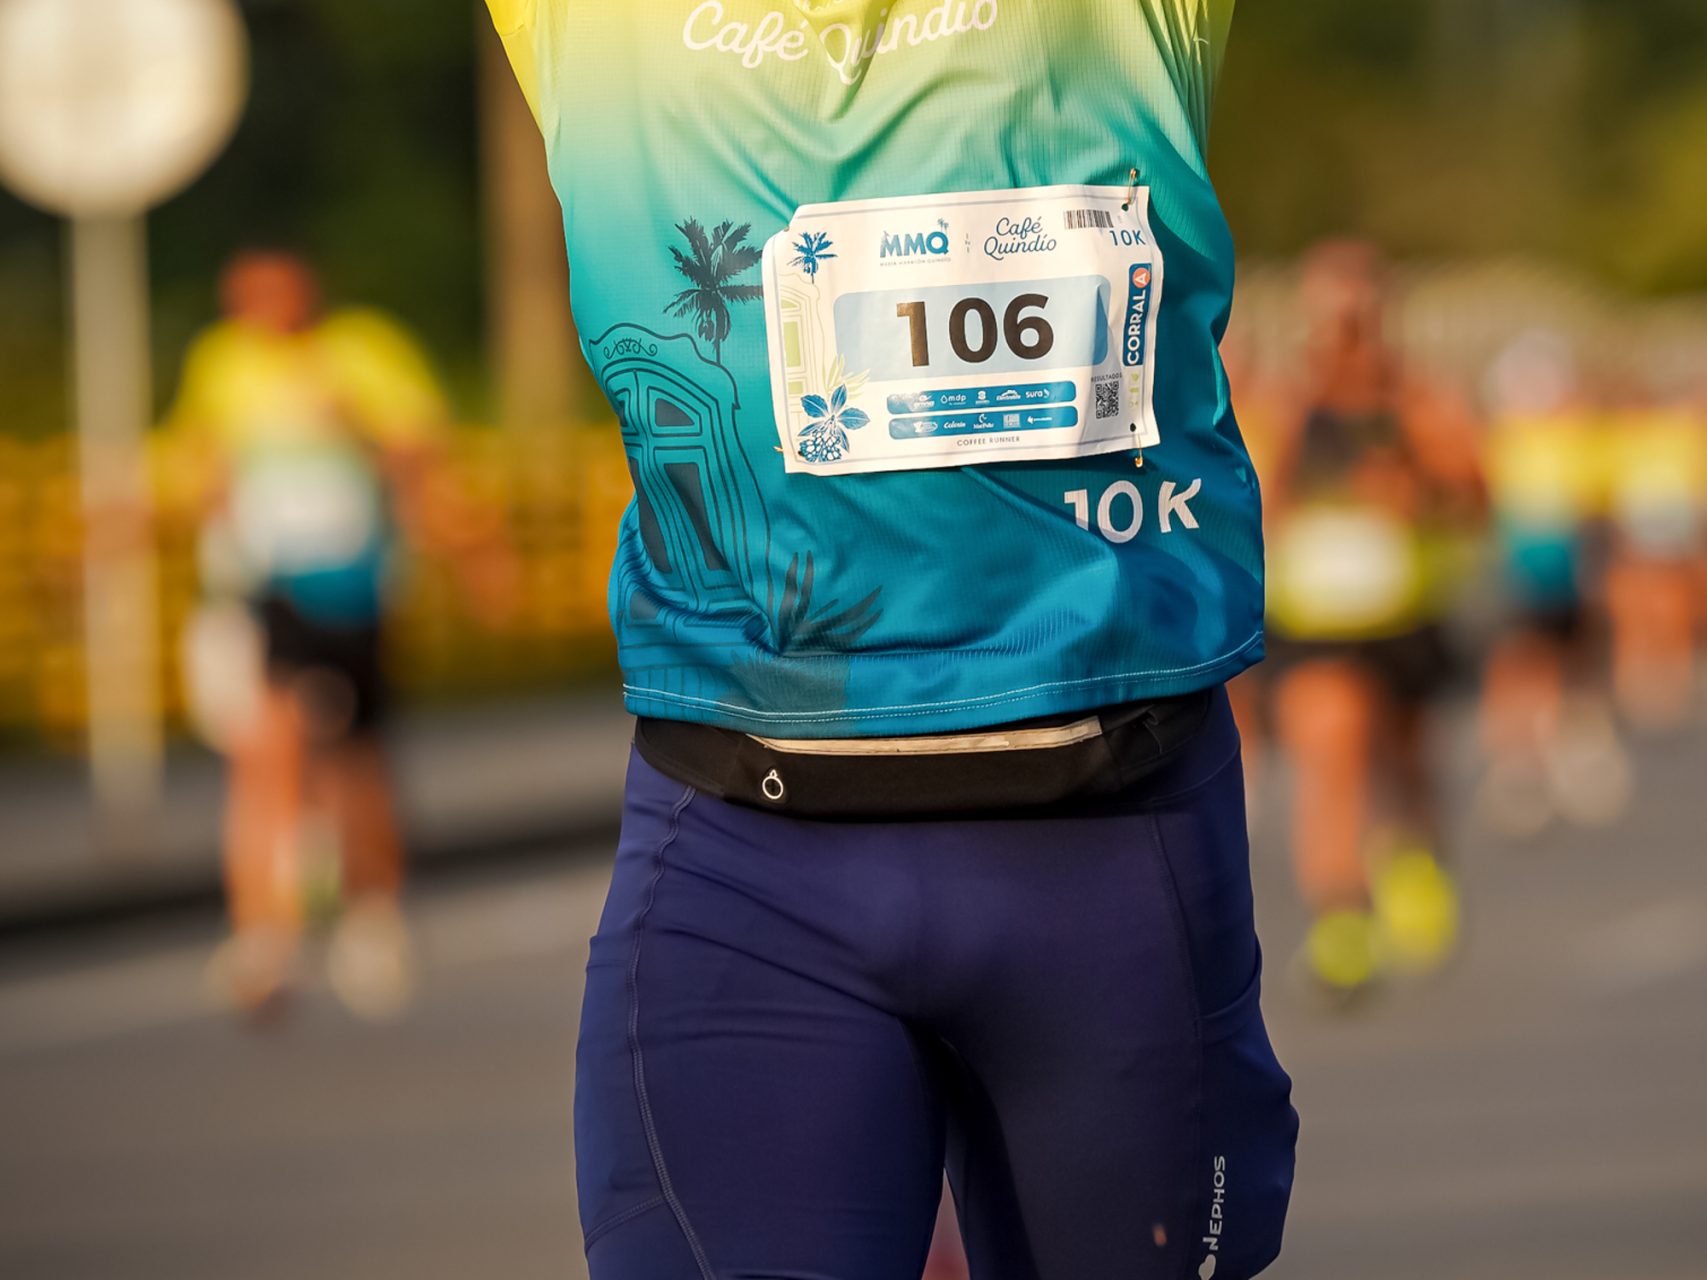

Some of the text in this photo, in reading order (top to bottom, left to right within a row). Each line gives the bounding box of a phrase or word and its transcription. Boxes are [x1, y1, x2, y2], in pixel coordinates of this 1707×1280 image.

[682, 0, 809, 68] Café
[996, 216, 1042, 240] Café
[1109, 229, 1146, 246] 10K
[880, 230, 949, 258] MMQ
[984, 233, 1057, 261] Quindío
[896, 294, 1054, 367] 106
[1127, 273, 1147, 365] CORRAL A
[1025, 390, 1043, 399] sura
[957, 436, 1020, 447] COFFEE RUNNER
[1203, 1156, 1225, 1250] NEPHOS
